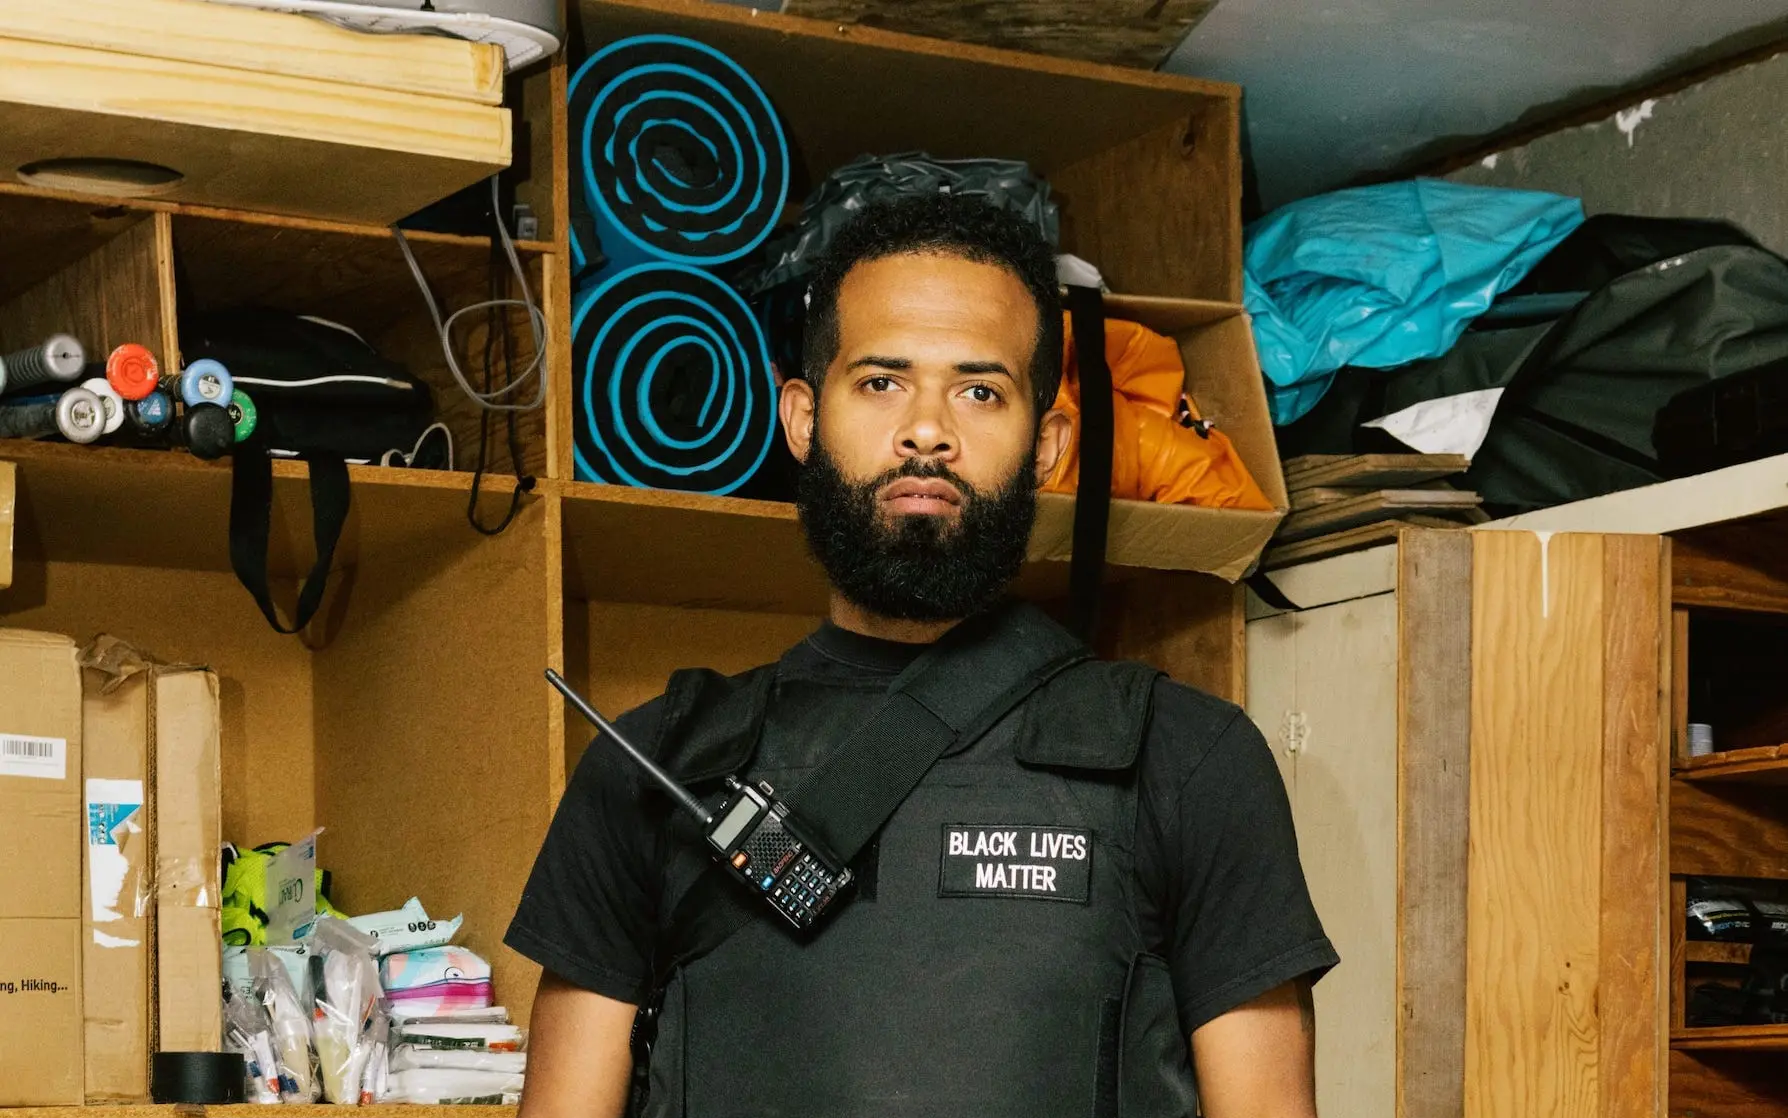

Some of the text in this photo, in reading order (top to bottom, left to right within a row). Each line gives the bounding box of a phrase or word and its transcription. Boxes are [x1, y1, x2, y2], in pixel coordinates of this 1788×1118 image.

[949, 831, 1086, 860] BLACK LIVES
[975, 863, 1057, 891] MATTER
[21, 979, 68, 993] Hiking...
